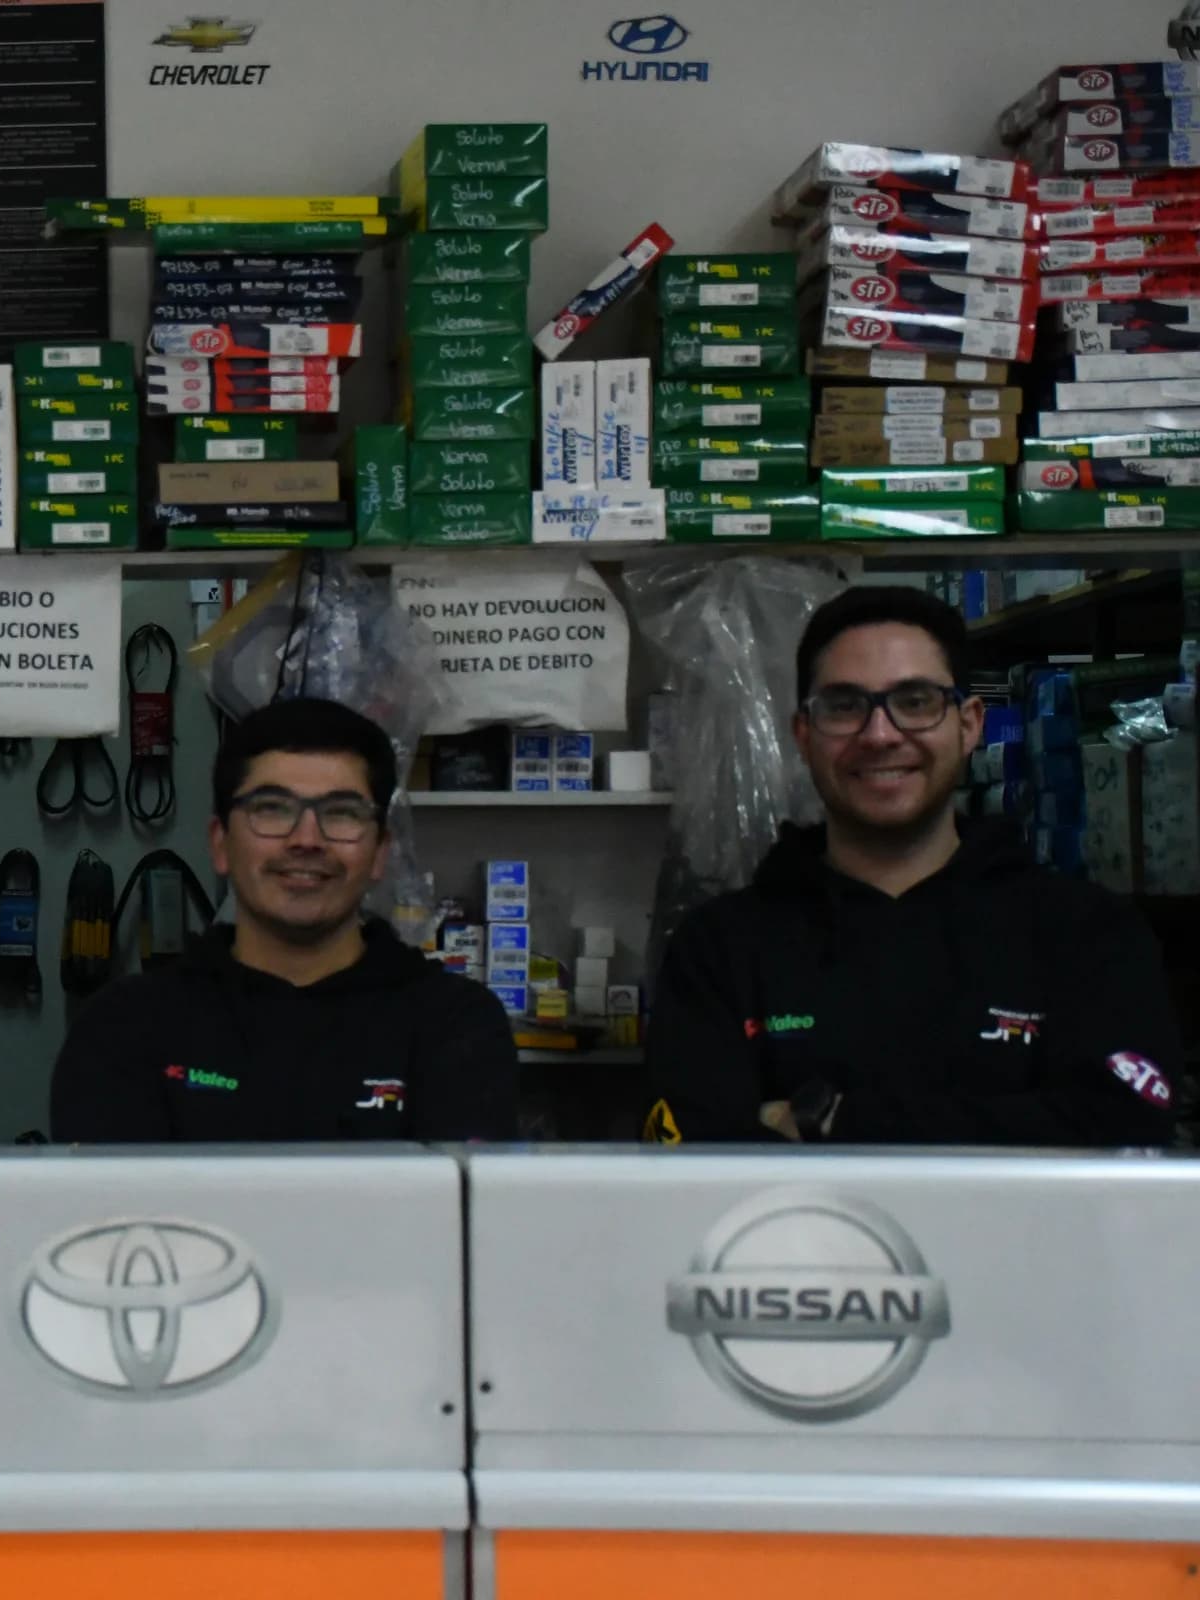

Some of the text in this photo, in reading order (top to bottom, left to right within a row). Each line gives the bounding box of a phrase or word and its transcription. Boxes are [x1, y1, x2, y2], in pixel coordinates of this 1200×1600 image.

[149, 64, 270, 86] CHEVROLET
[582, 61, 709, 82] HYUNDAI
[1083, 73, 1105, 88] STP
[1091, 108, 1113, 123] STP
[1088, 143, 1111, 158] STP
[857, 197, 889, 216] STP
[856, 280, 887, 299] STP
[852, 318, 882, 336] STP
[196, 333, 220, 348] STP
[1047, 468, 1071, 484] STP
[39, 591, 55, 608] O
[408, 597, 606, 619] NO HAY DEVOLUCION
[432, 624, 606, 645] DINERO PAGO CON
[18, 653, 94, 671] BOLETA
[440, 653, 594, 673] RJETA DE DEBITO
[188, 1067, 240, 1091] Valeo
[1110, 1053, 1171, 1101] STP
[694, 1286, 922, 1323] NISSAN
